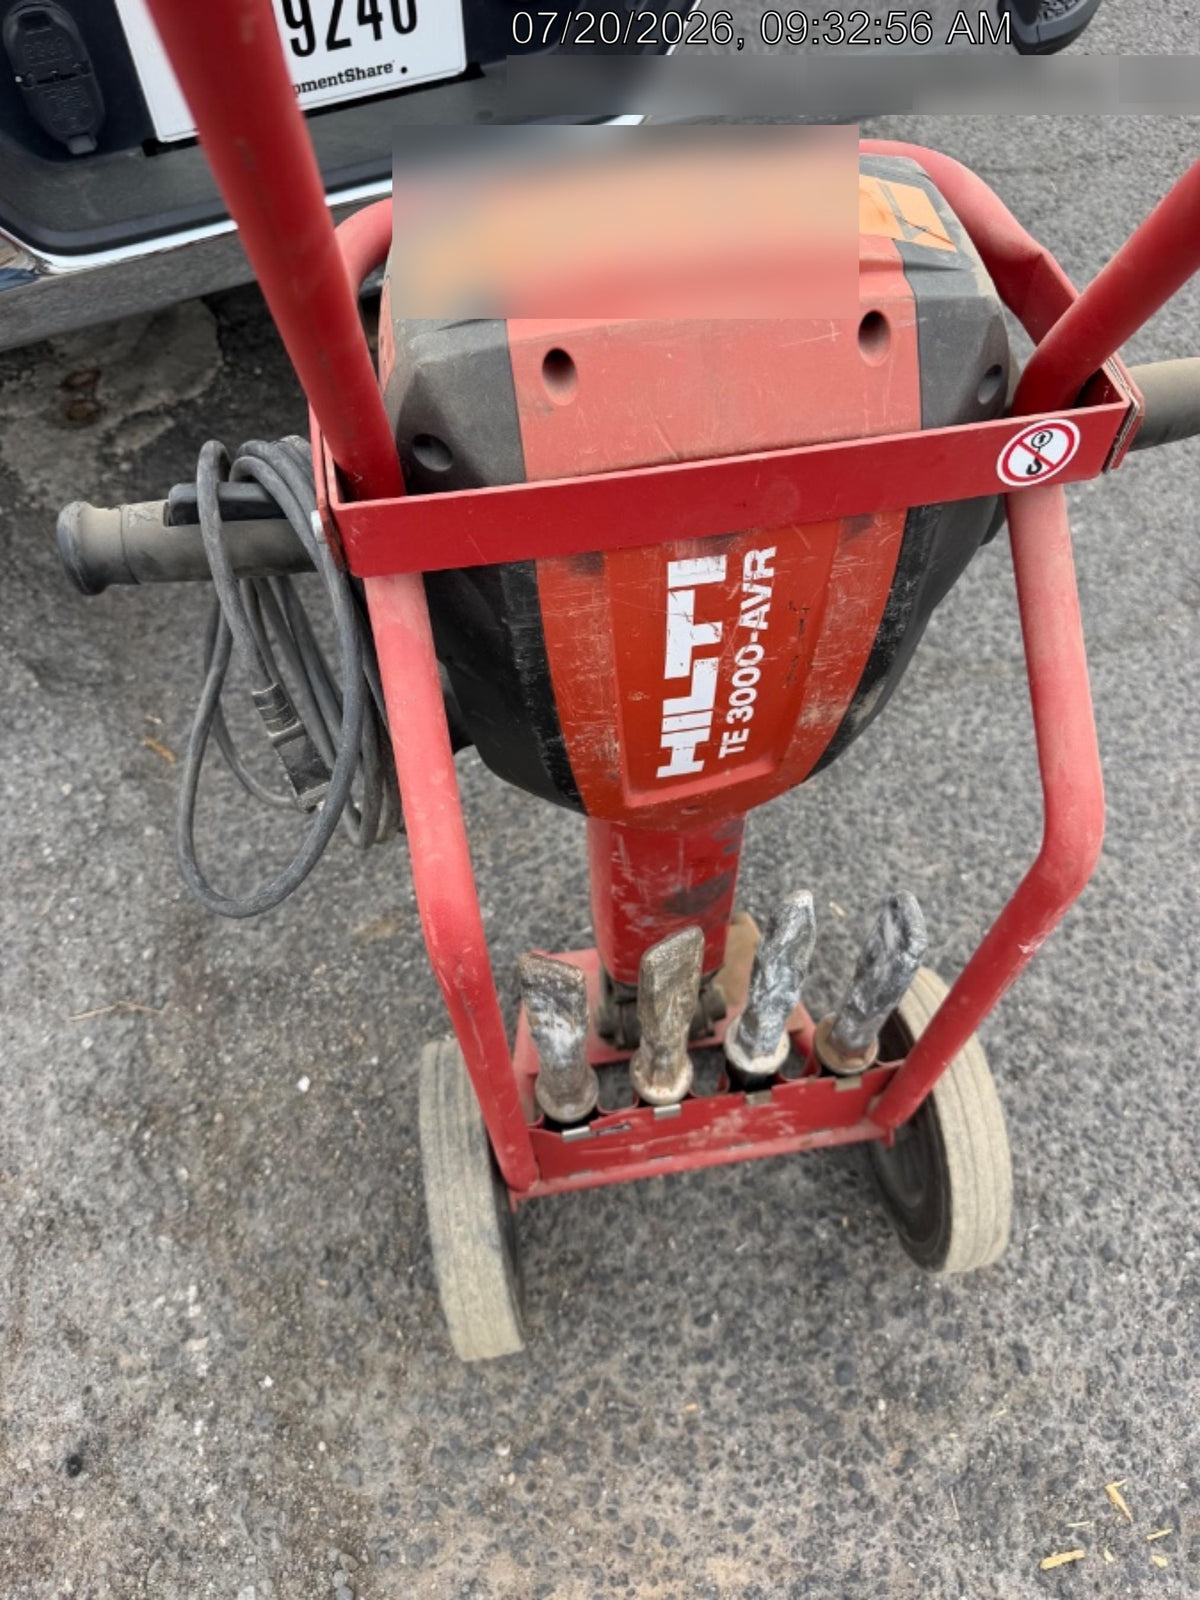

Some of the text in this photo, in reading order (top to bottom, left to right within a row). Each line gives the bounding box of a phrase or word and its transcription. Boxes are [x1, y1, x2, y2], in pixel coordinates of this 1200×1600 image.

[656, 554, 727, 778] HILTI
[718, 546, 777, 759] TE 3000-AVR
